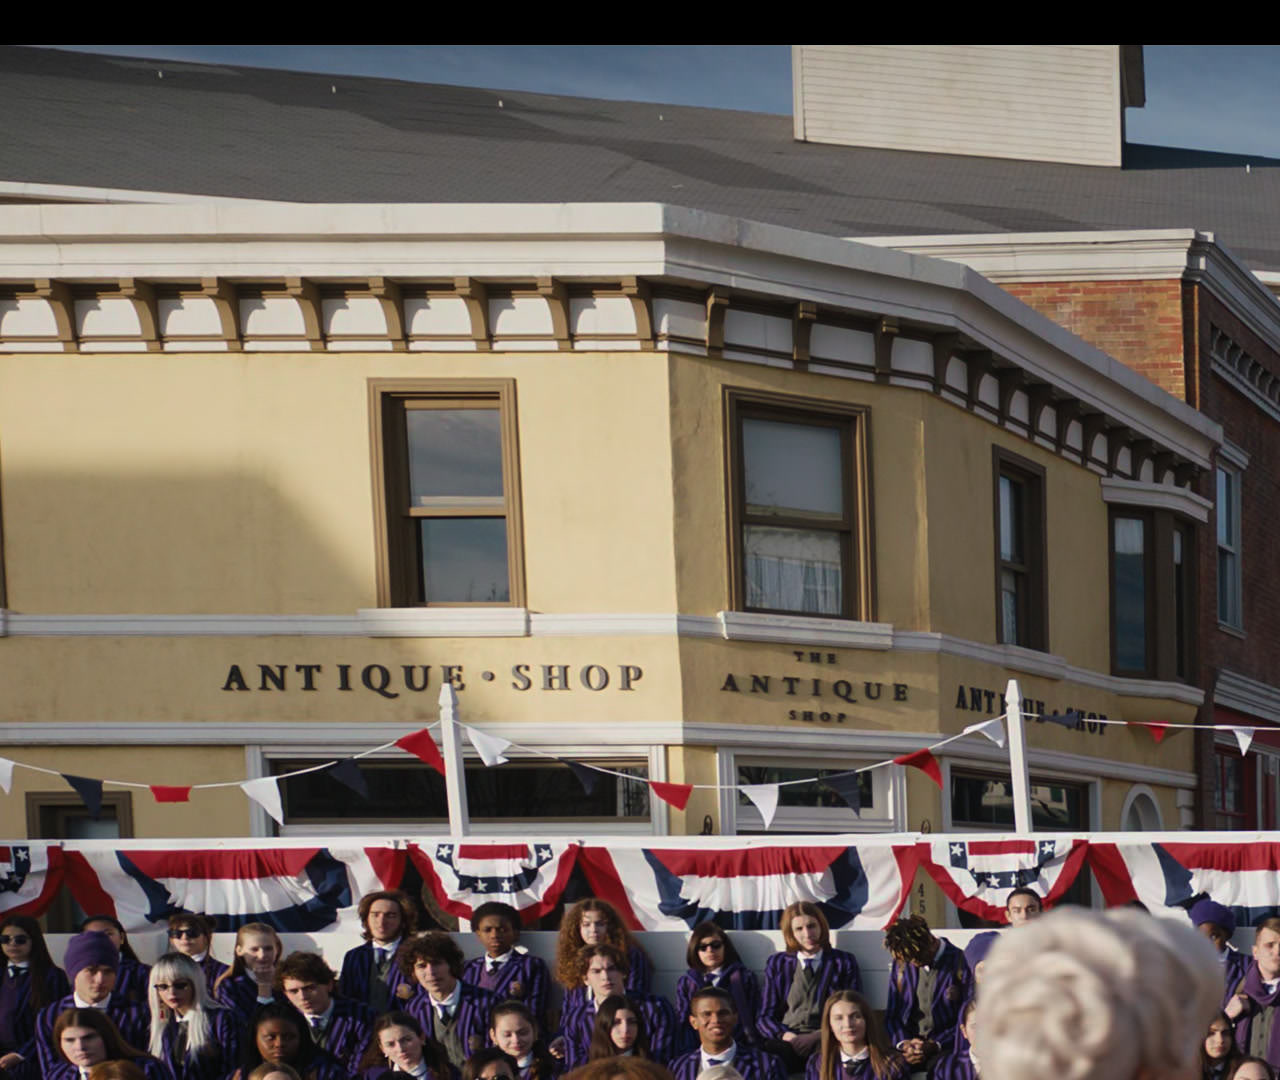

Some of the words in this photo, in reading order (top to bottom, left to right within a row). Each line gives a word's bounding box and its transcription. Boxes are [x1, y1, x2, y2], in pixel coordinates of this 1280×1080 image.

[793, 651, 836, 664] THE
[221, 664, 465, 699] ANTIQUE
[511, 664, 644, 691] SHOP
[720, 673, 909, 703] ANTIQUE
[789, 710, 847, 723] SHOP
